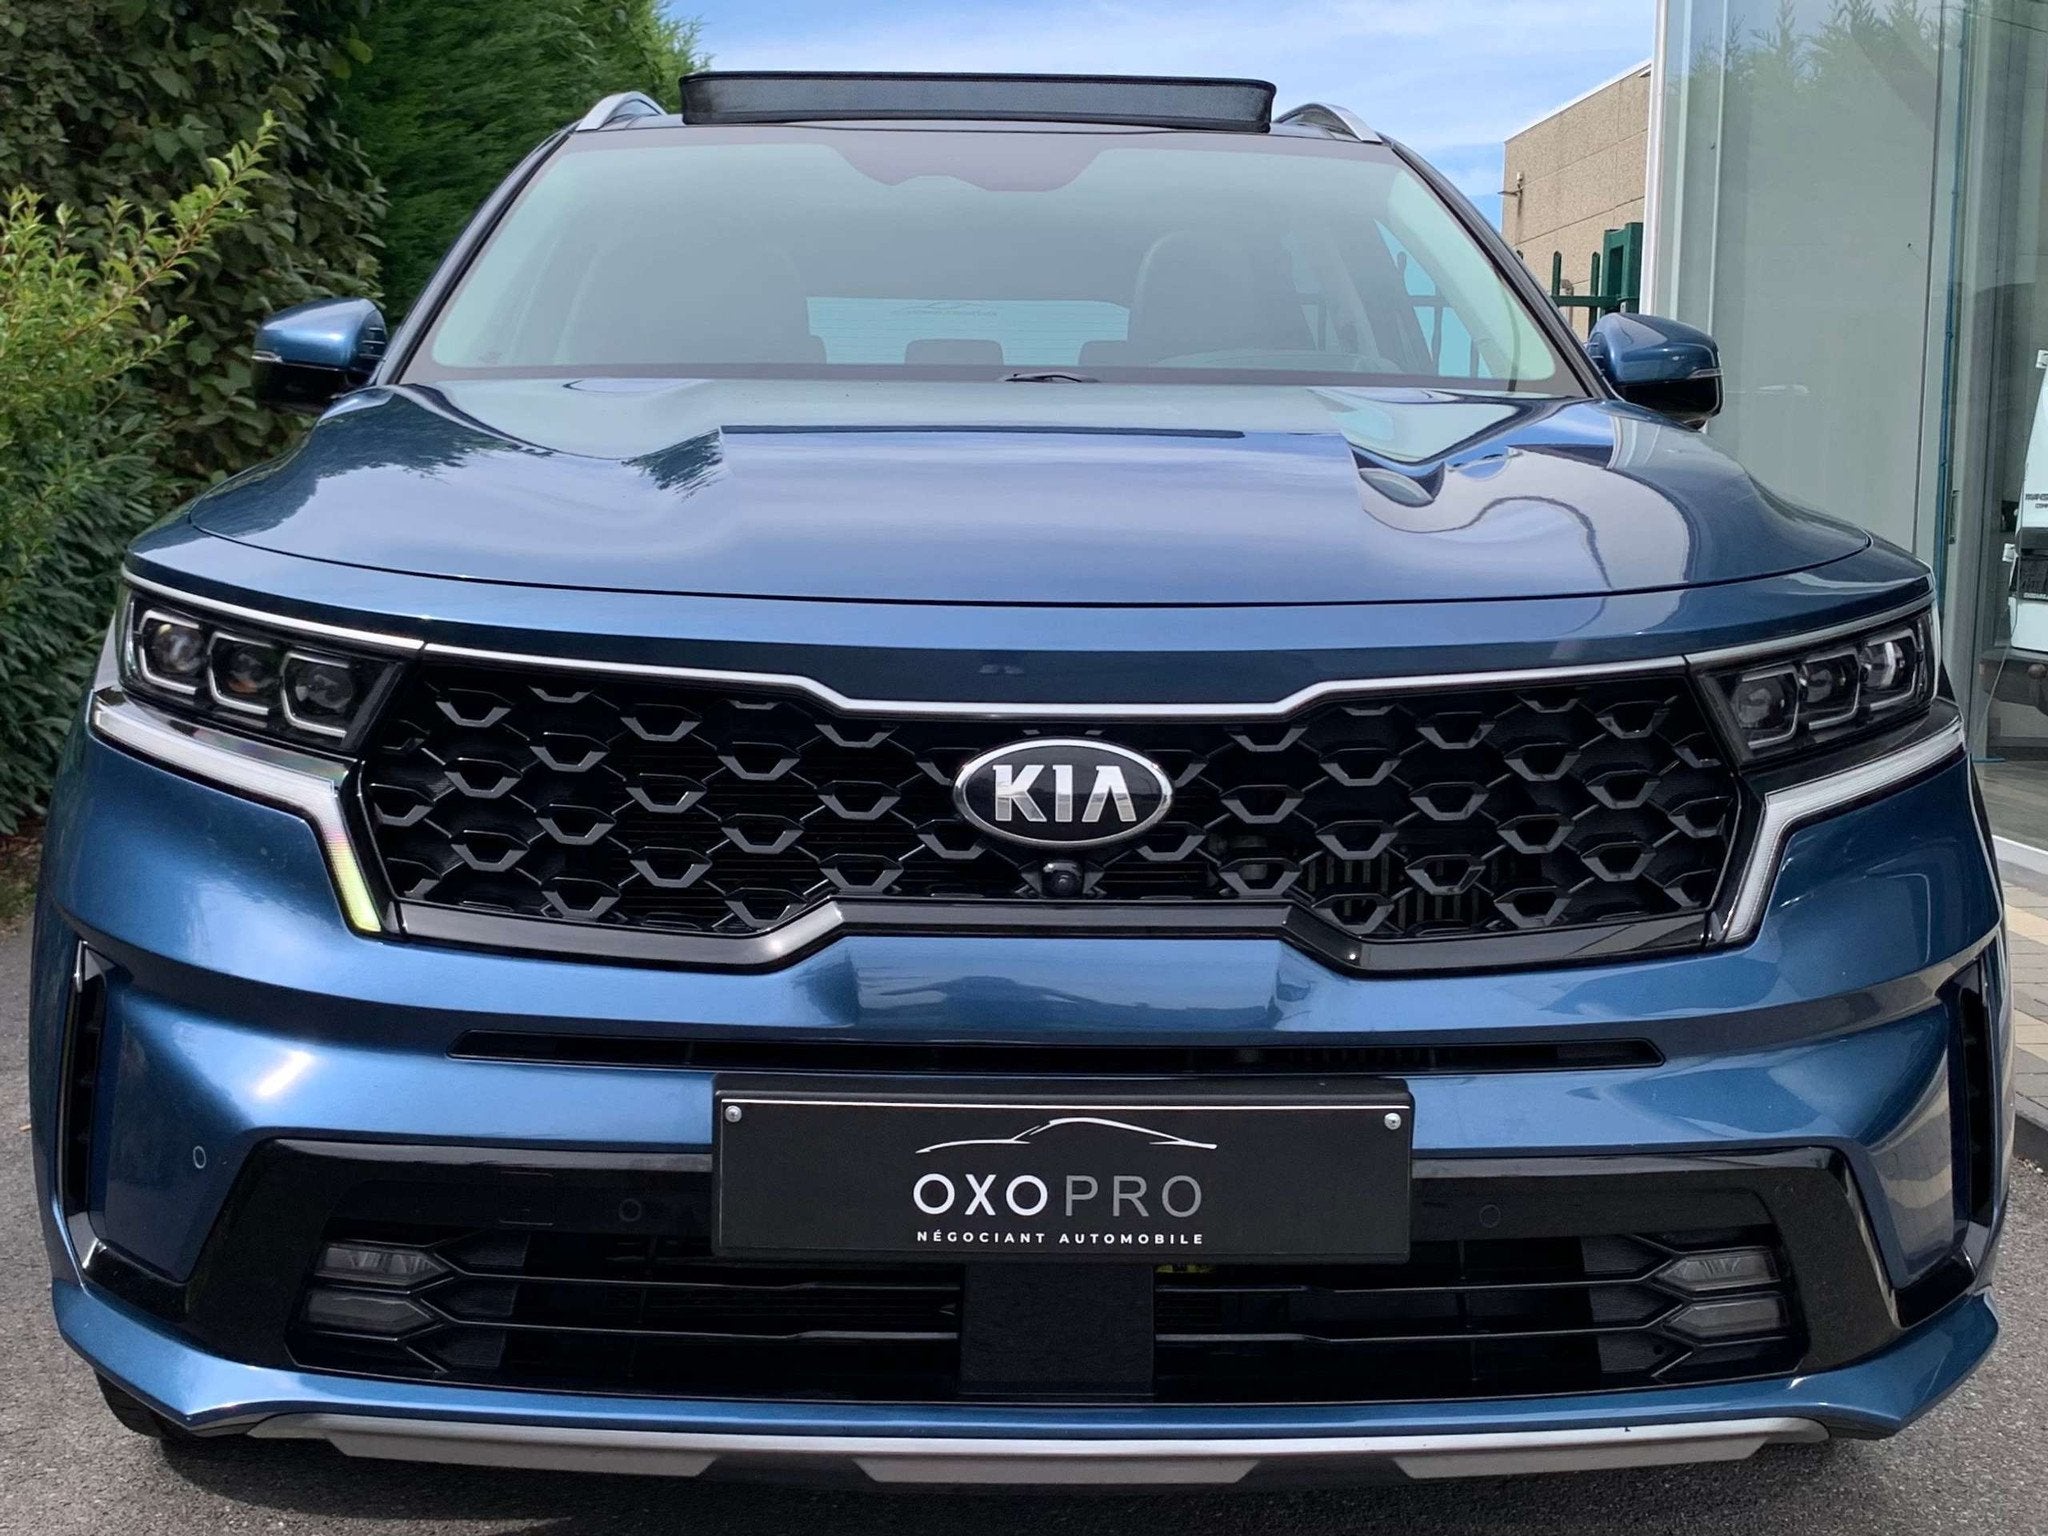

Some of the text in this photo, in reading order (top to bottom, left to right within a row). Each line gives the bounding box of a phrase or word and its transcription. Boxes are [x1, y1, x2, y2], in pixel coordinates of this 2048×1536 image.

[992, 764, 1137, 823] KIA
[916, 1229, 1203, 1245] NÉGOCIANT AUTOMOBILE
